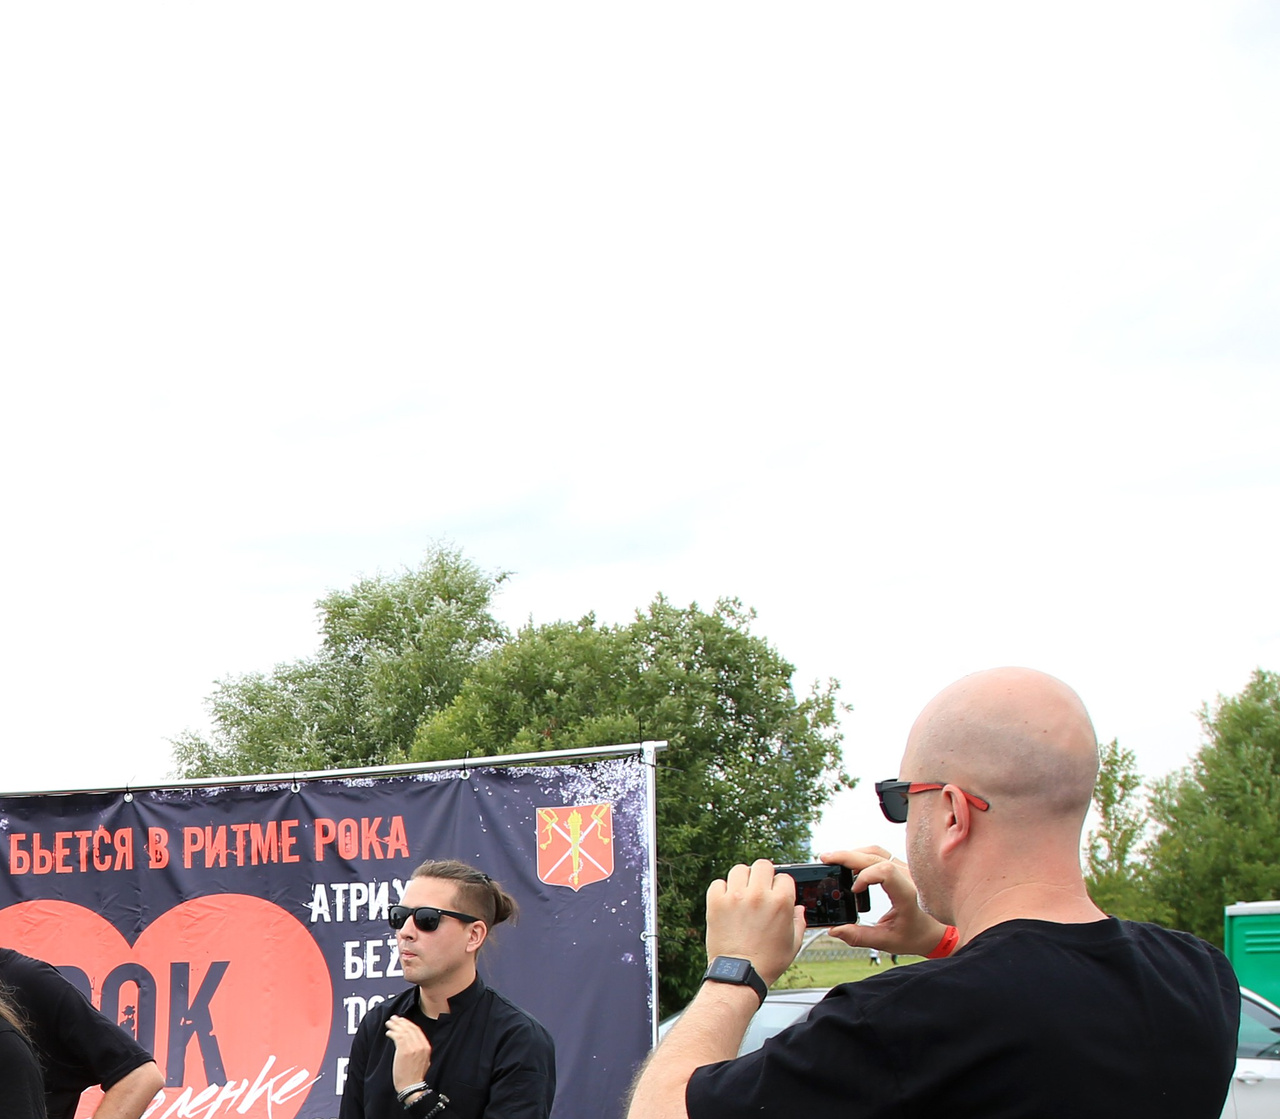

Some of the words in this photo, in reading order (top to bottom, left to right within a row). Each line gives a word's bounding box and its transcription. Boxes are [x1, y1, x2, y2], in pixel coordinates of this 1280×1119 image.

[9, 826, 134, 875] БЬЕТСЯ
[145, 826, 170, 869] В
[183, 819, 301, 869] РИТМЕ
[314, 815, 410, 861] РОКА
